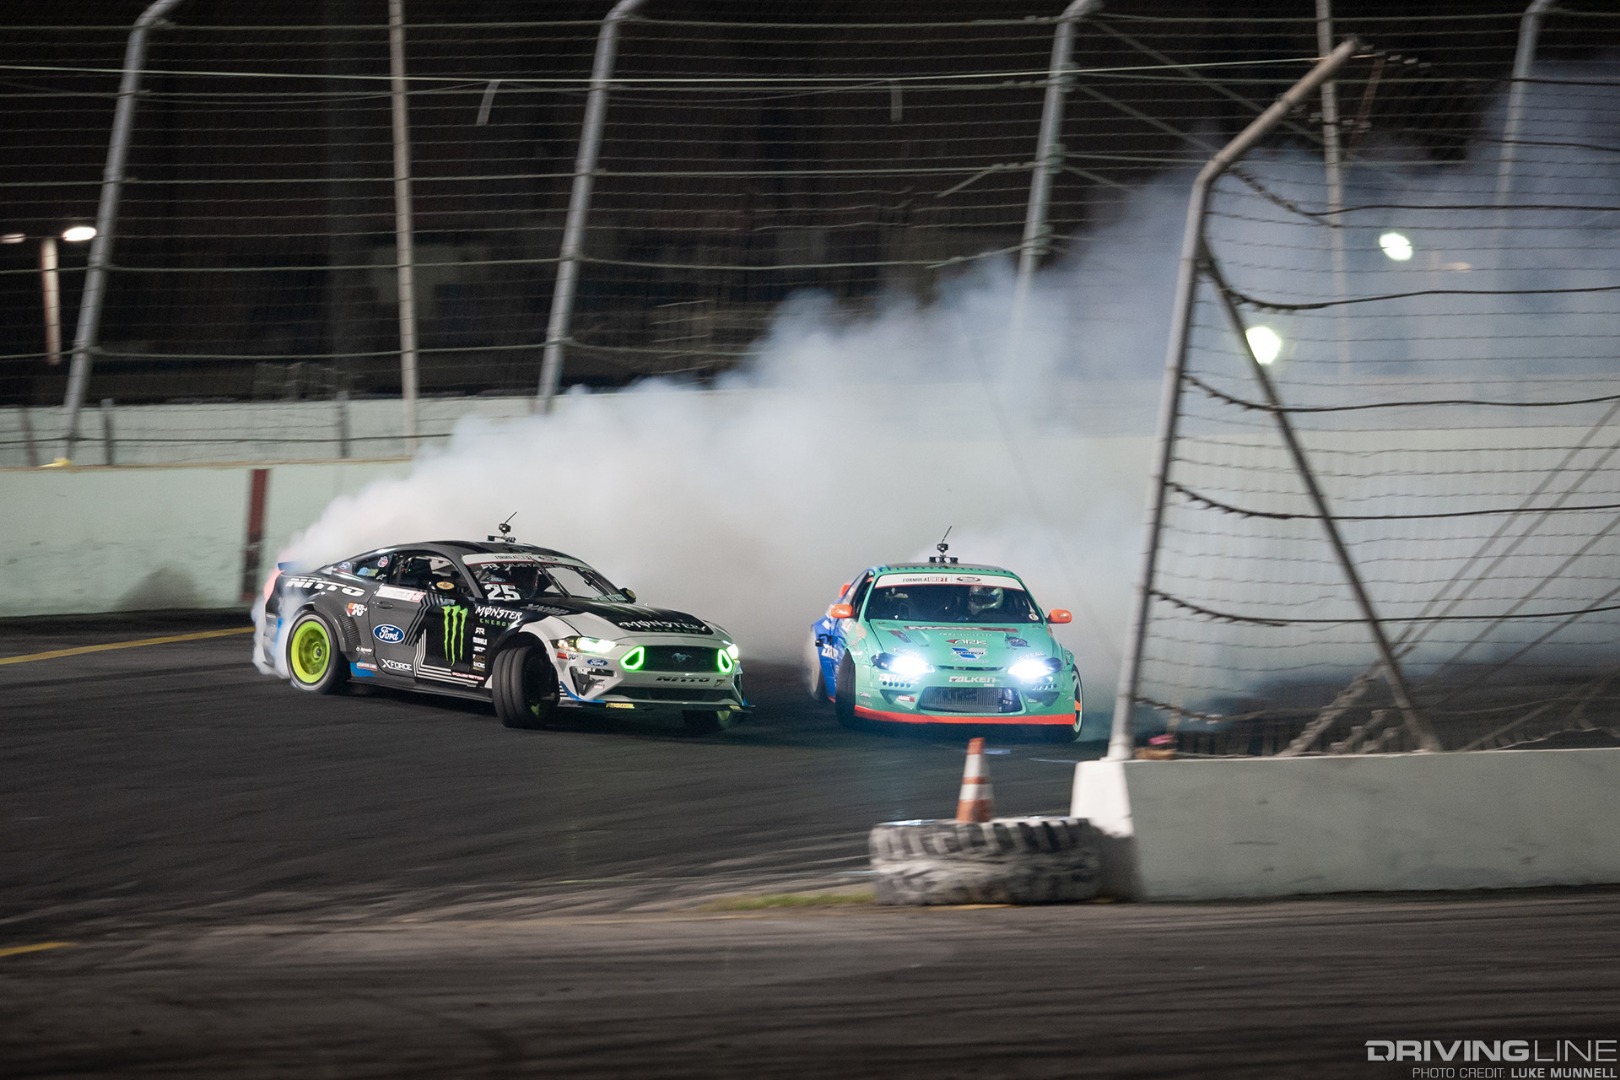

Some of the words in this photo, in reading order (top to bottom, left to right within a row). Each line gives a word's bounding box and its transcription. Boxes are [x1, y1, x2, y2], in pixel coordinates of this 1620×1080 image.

[285, 577, 366, 597] NITTO
[484, 583, 521, 601] 25
[376, 625, 401, 642] Ford
[656, 675, 711, 683] NITTO
[948, 675, 996, 683] FALKEN
